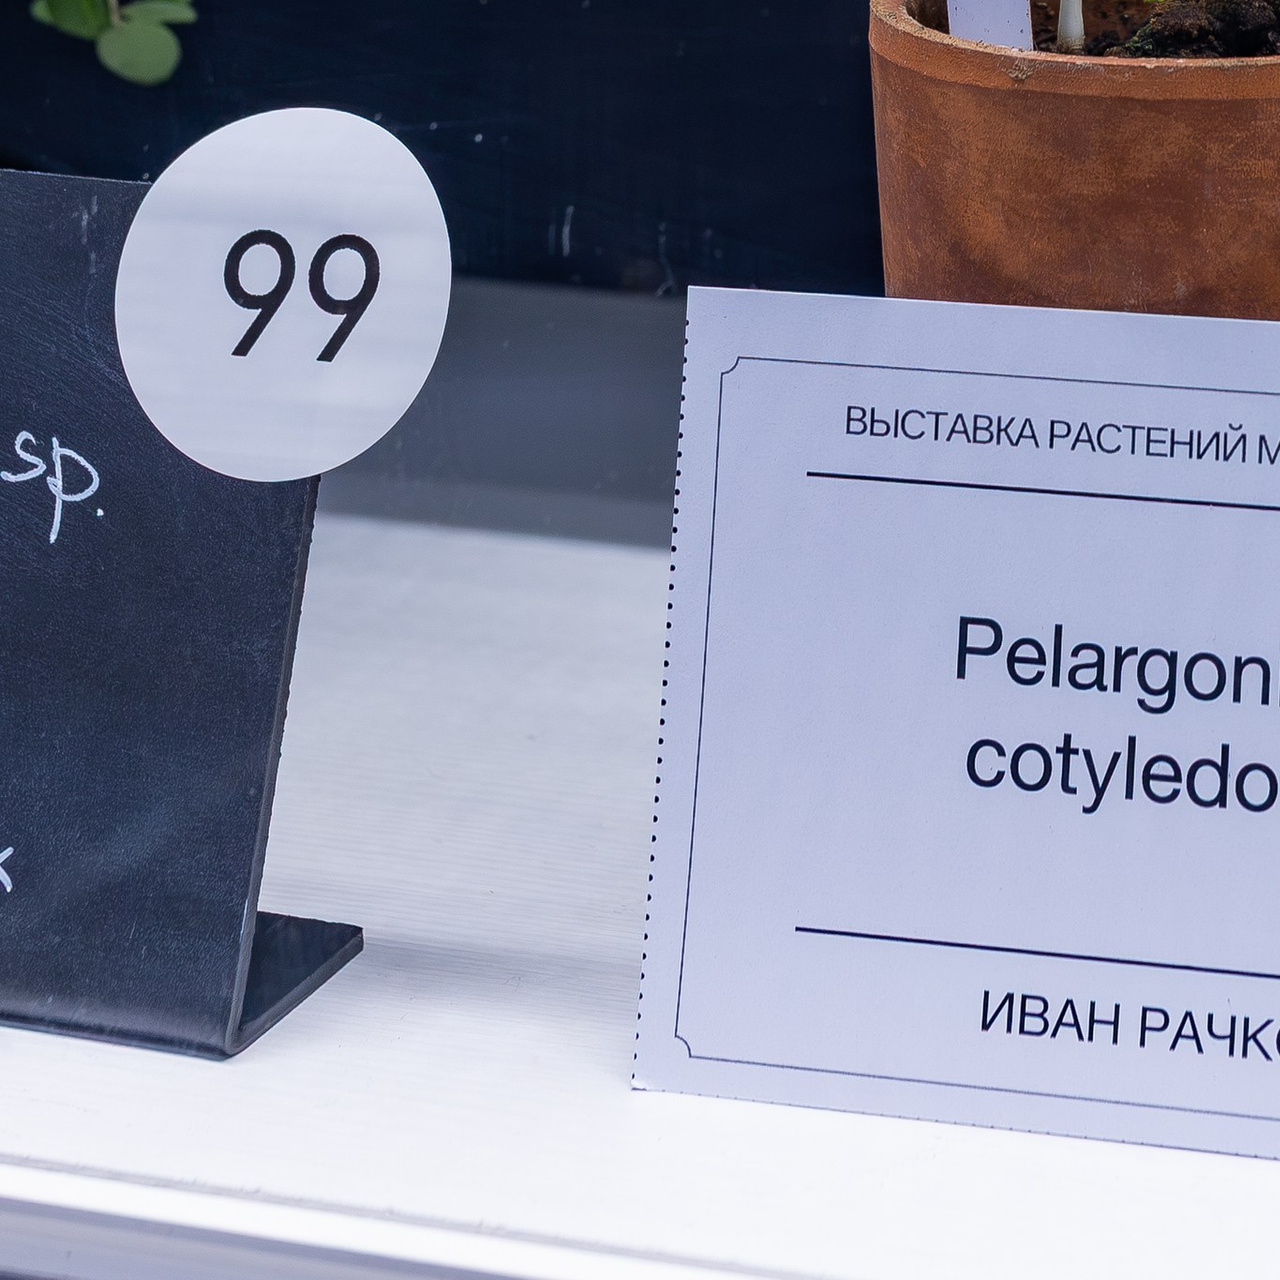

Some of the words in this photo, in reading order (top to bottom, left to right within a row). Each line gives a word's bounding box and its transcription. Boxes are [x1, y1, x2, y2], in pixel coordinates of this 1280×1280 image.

[222, 228, 381, 363] 99
[845, 404, 1040, 449] ВЫСТАВКА
[1048, 419, 1248, 463] РАСТЕНИЙ
[0, 430, 104, 544] sp.
[980, 989, 1121, 1046] ИВАН
